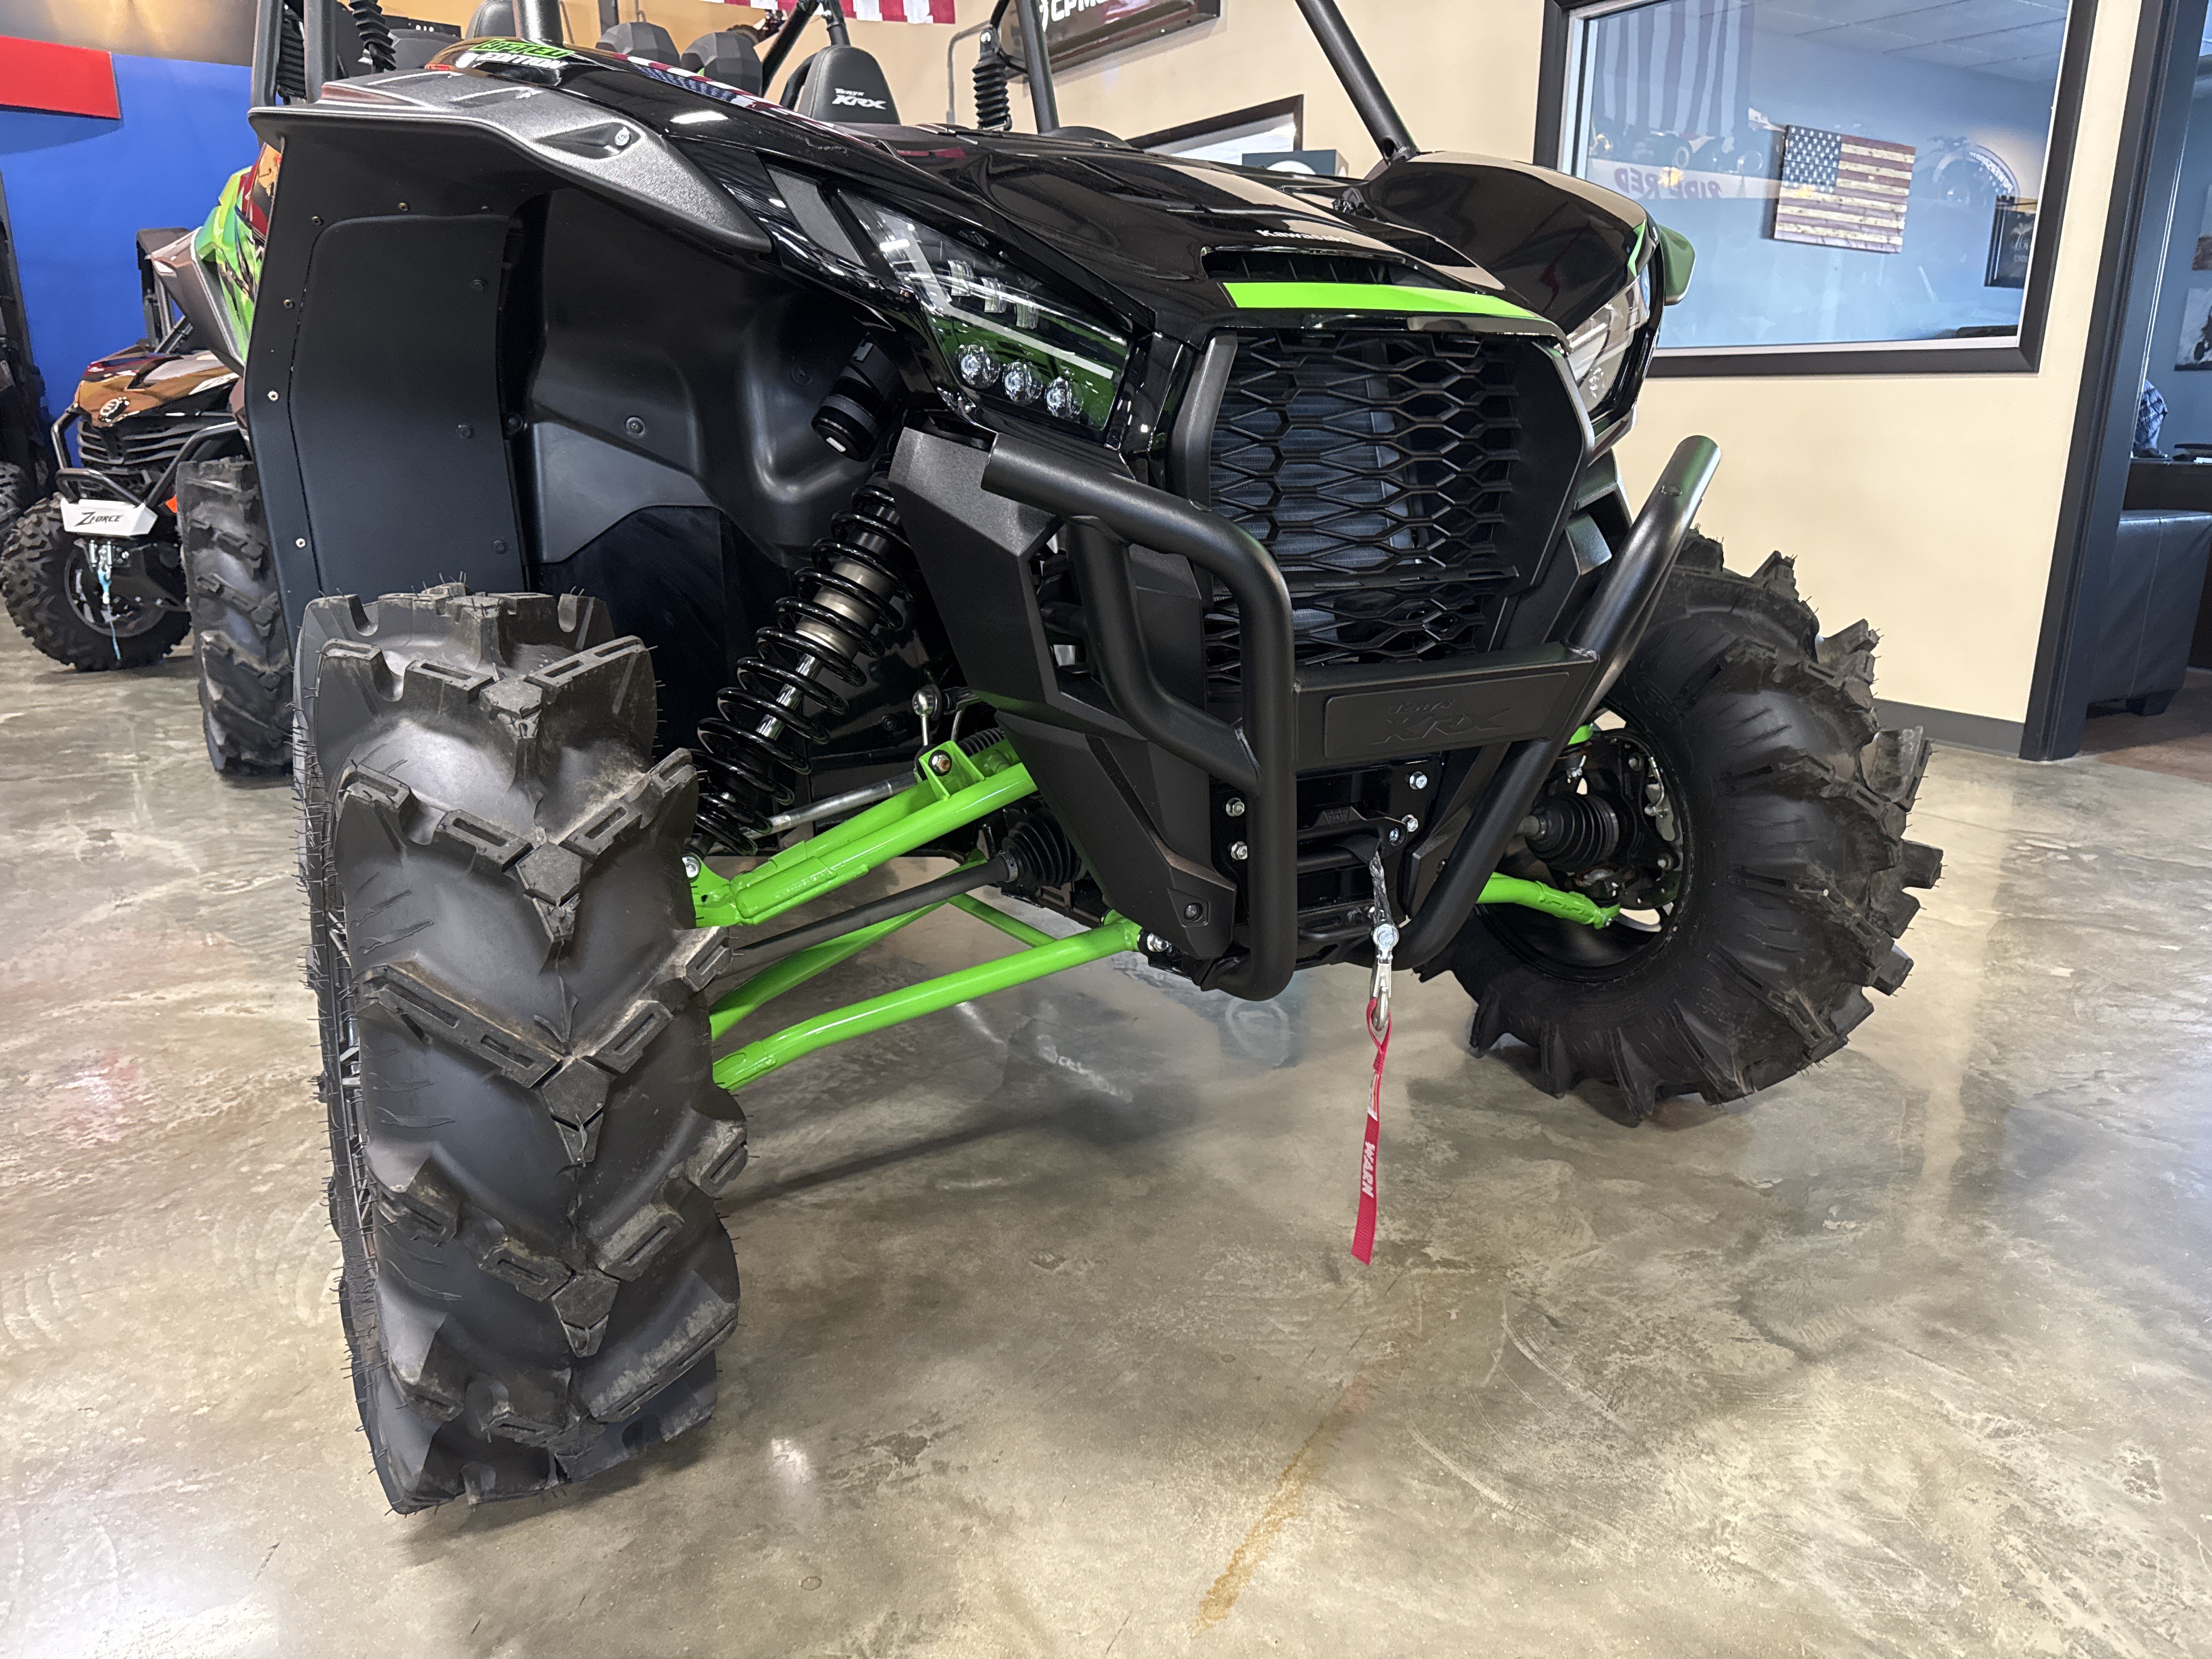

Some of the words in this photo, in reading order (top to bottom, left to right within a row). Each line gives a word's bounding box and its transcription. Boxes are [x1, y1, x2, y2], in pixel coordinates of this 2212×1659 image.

[476, 52, 569, 69] EDITION
[832, 94, 887, 110] KRX
[1255, 229, 1352, 244] Kawasaki
[1362, 1141, 1375, 1198] WARN
